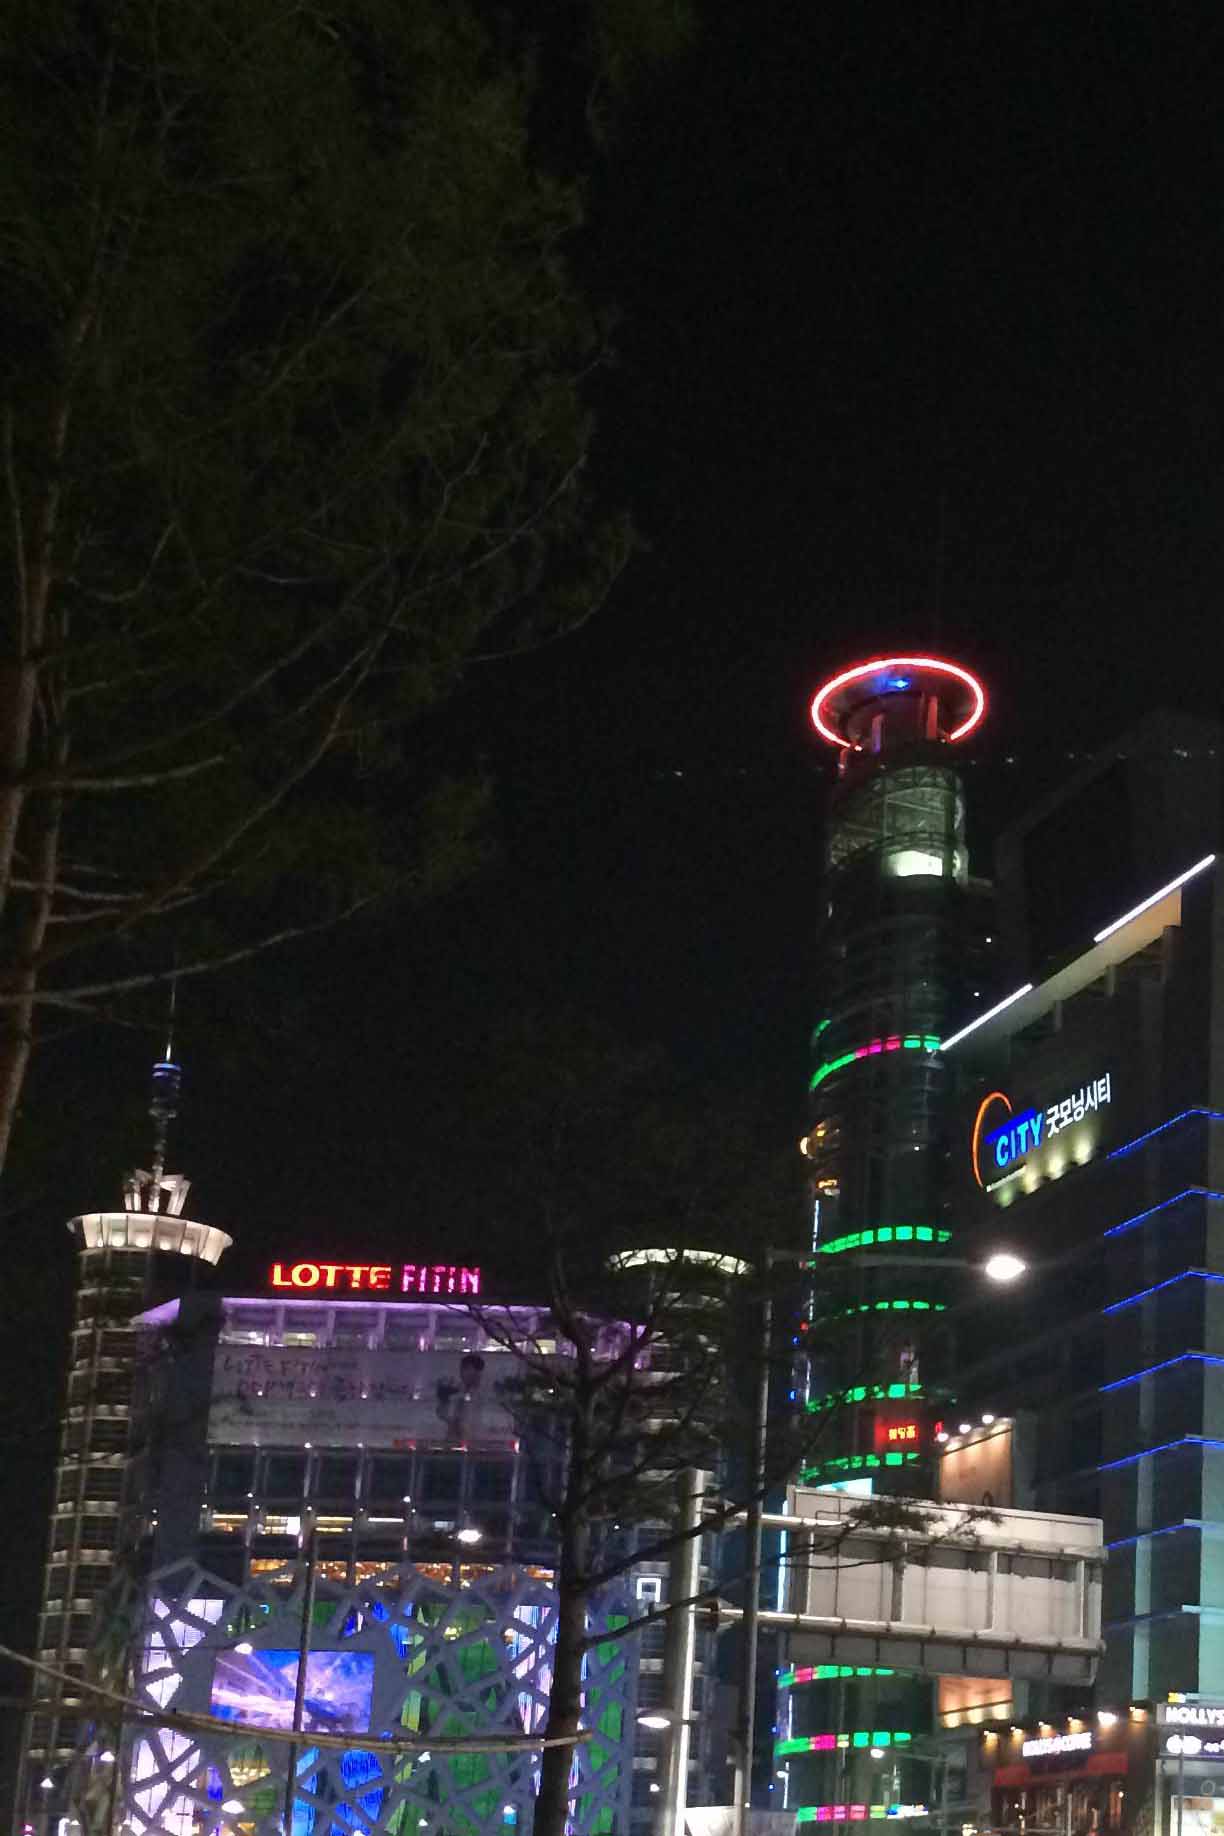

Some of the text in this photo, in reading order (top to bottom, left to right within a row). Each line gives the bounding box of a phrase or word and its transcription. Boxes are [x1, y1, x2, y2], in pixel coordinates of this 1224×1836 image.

[1046, 1072, 1111, 1138] 굿모닝시티
[995, 1112, 1044, 1168] CITY
[272, 1263, 480, 1294] LOTTE FITIN
